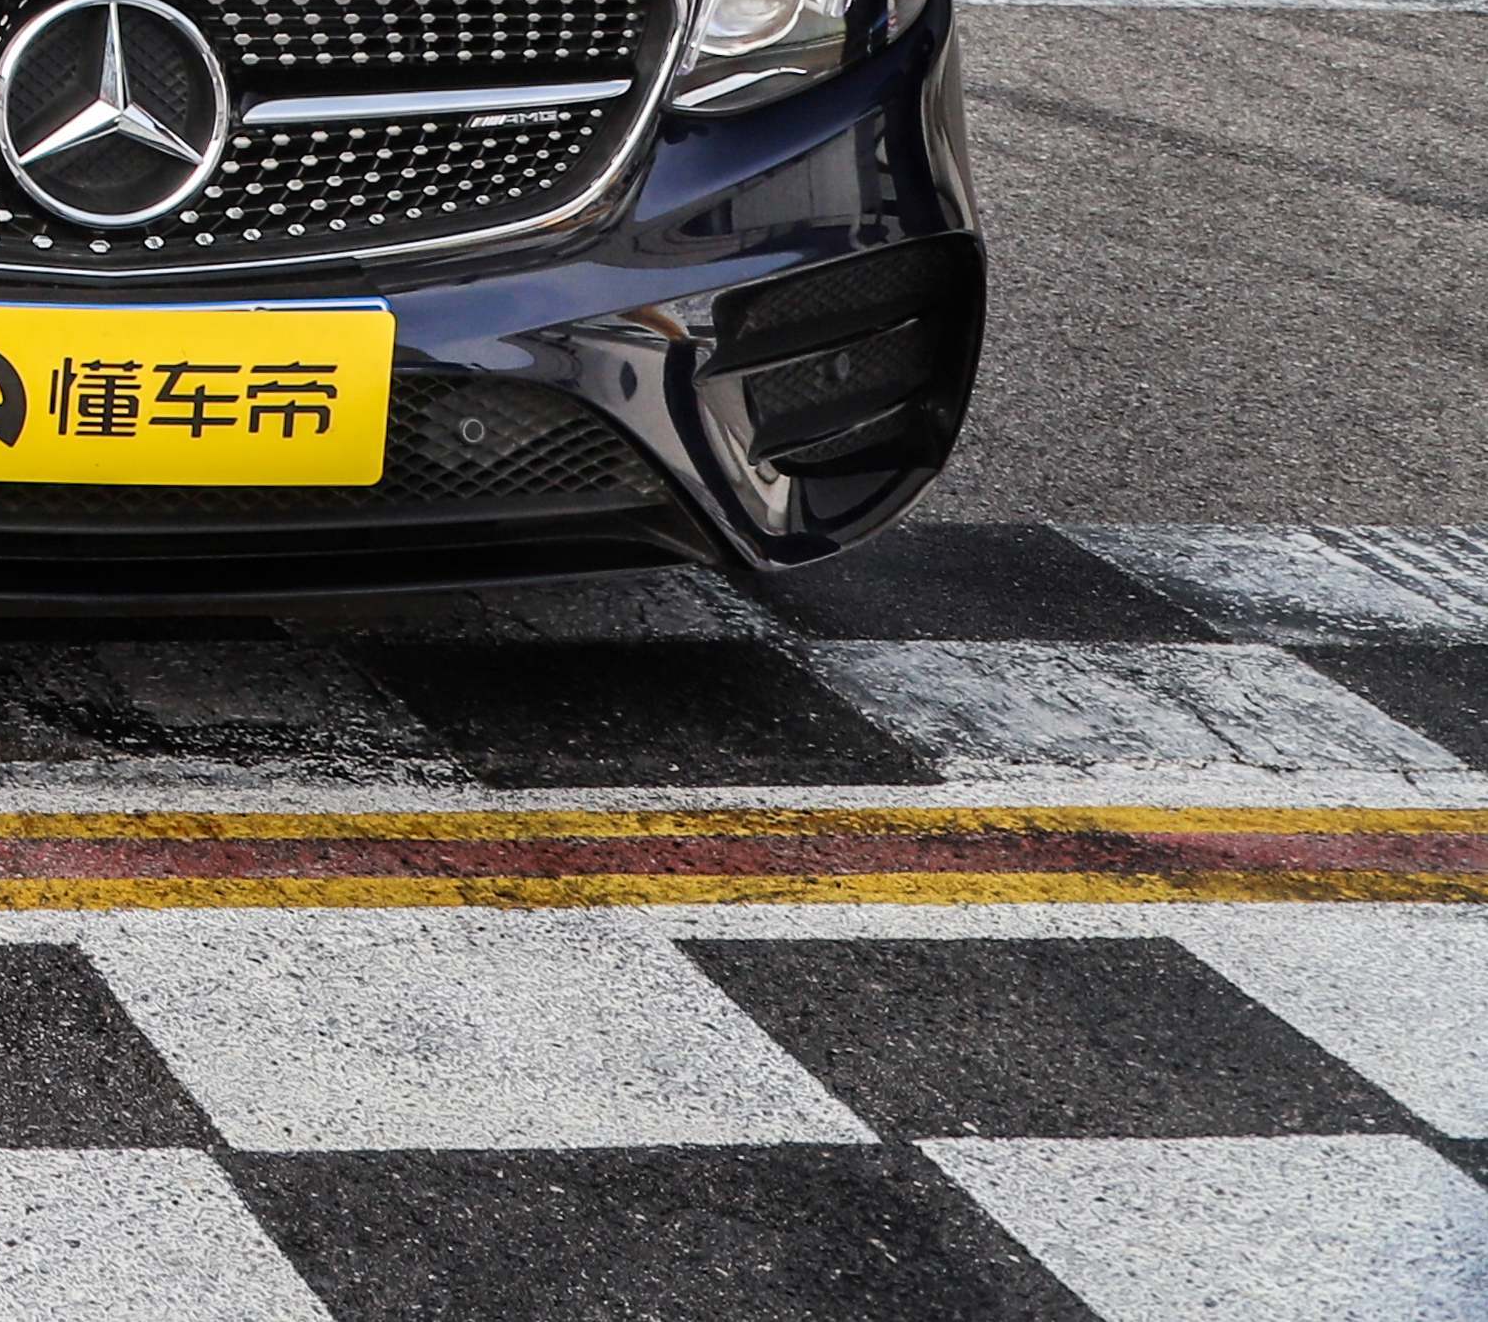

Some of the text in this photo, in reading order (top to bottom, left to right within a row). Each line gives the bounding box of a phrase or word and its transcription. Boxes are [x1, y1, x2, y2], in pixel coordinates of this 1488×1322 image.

[504, 109, 558, 124] AMG
[49, 357, 339, 439] 懂车帝
